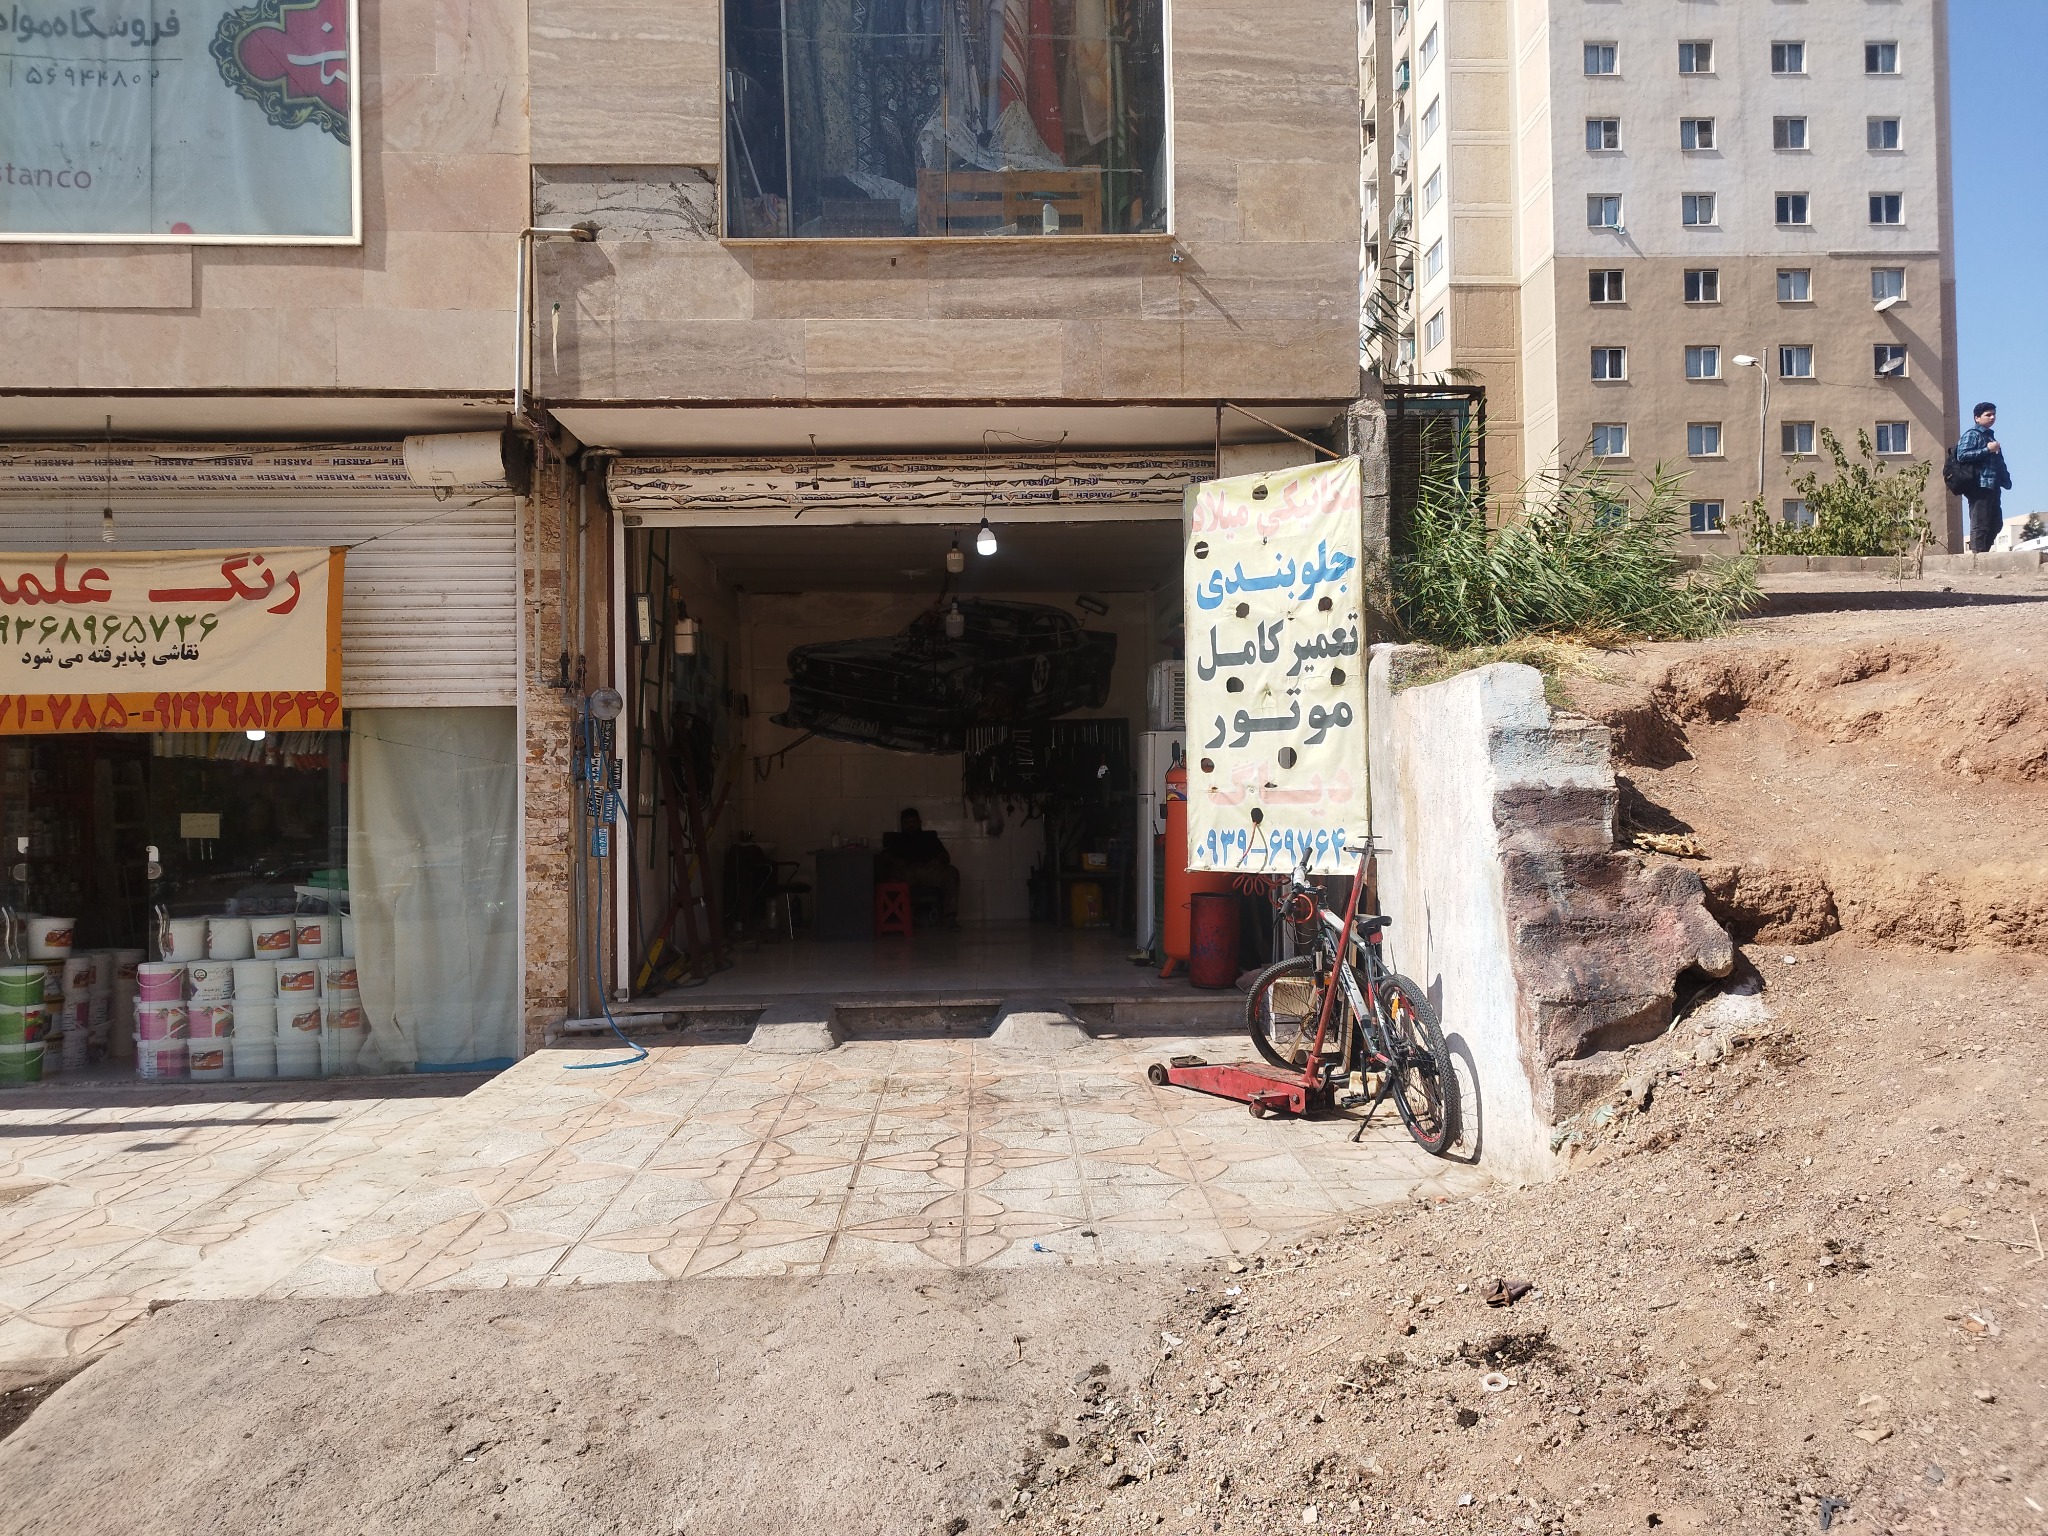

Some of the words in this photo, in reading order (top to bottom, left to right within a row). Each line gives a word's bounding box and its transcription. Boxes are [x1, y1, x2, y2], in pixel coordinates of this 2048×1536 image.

[0, 162, 92, 189] tanco
[214, 458, 253, 466] PARSEH
[273, 458, 313, 466] PARSEH
[332, 458, 372, 466] PARSEH
[138, 474, 178, 482] PARSEH
[1190, 475, 1214, 483] ARSE
[1192, 489, 1249, 540] میلاد
[0, 553, 112, 605] علم
[148, 552, 301, 615] رنگ
[152, 643, 200, 665] نقاشی
[1197, 618, 1285, 682] کامل
[1286, 612, 1359, 676] تعمیر
[21, 647, 54, 669] شود
[58, 653, 84, 669] می
[88, 645, 146, 668] پذیرفته
[1204, 687, 1354, 749] موتور
